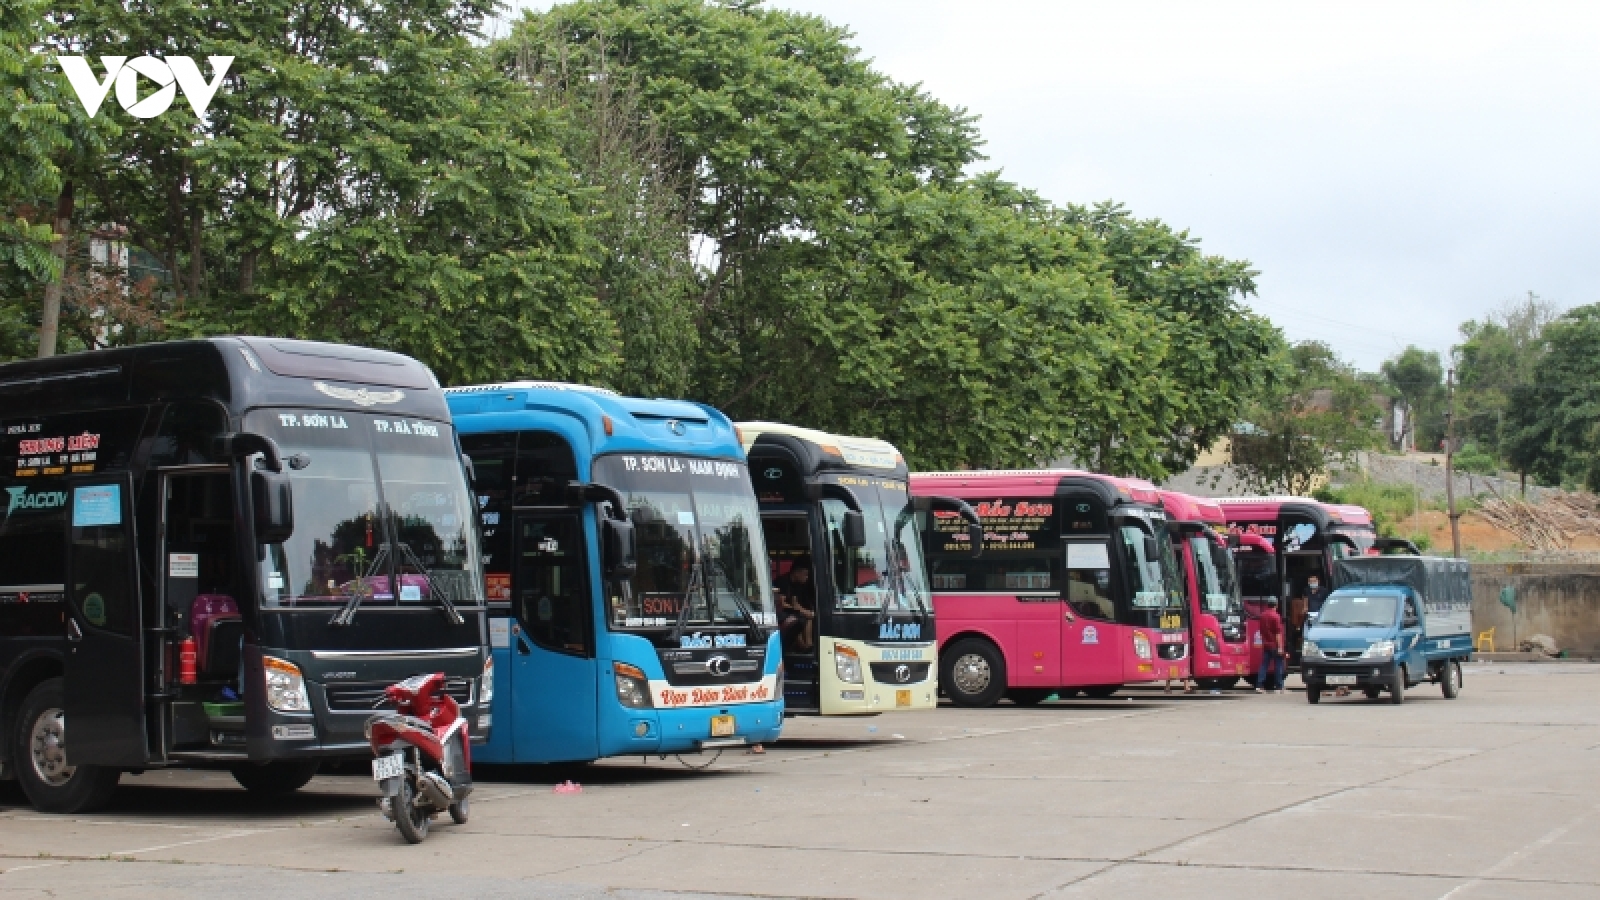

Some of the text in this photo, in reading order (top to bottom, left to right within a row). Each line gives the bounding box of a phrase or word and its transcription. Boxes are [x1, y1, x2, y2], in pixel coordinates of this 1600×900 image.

[330, 415, 349, 428] LA
[394, 419, 412, 434] HÀ
[622, 456, 640, 471] TP.
[688, 460, 714, 475] NAM
